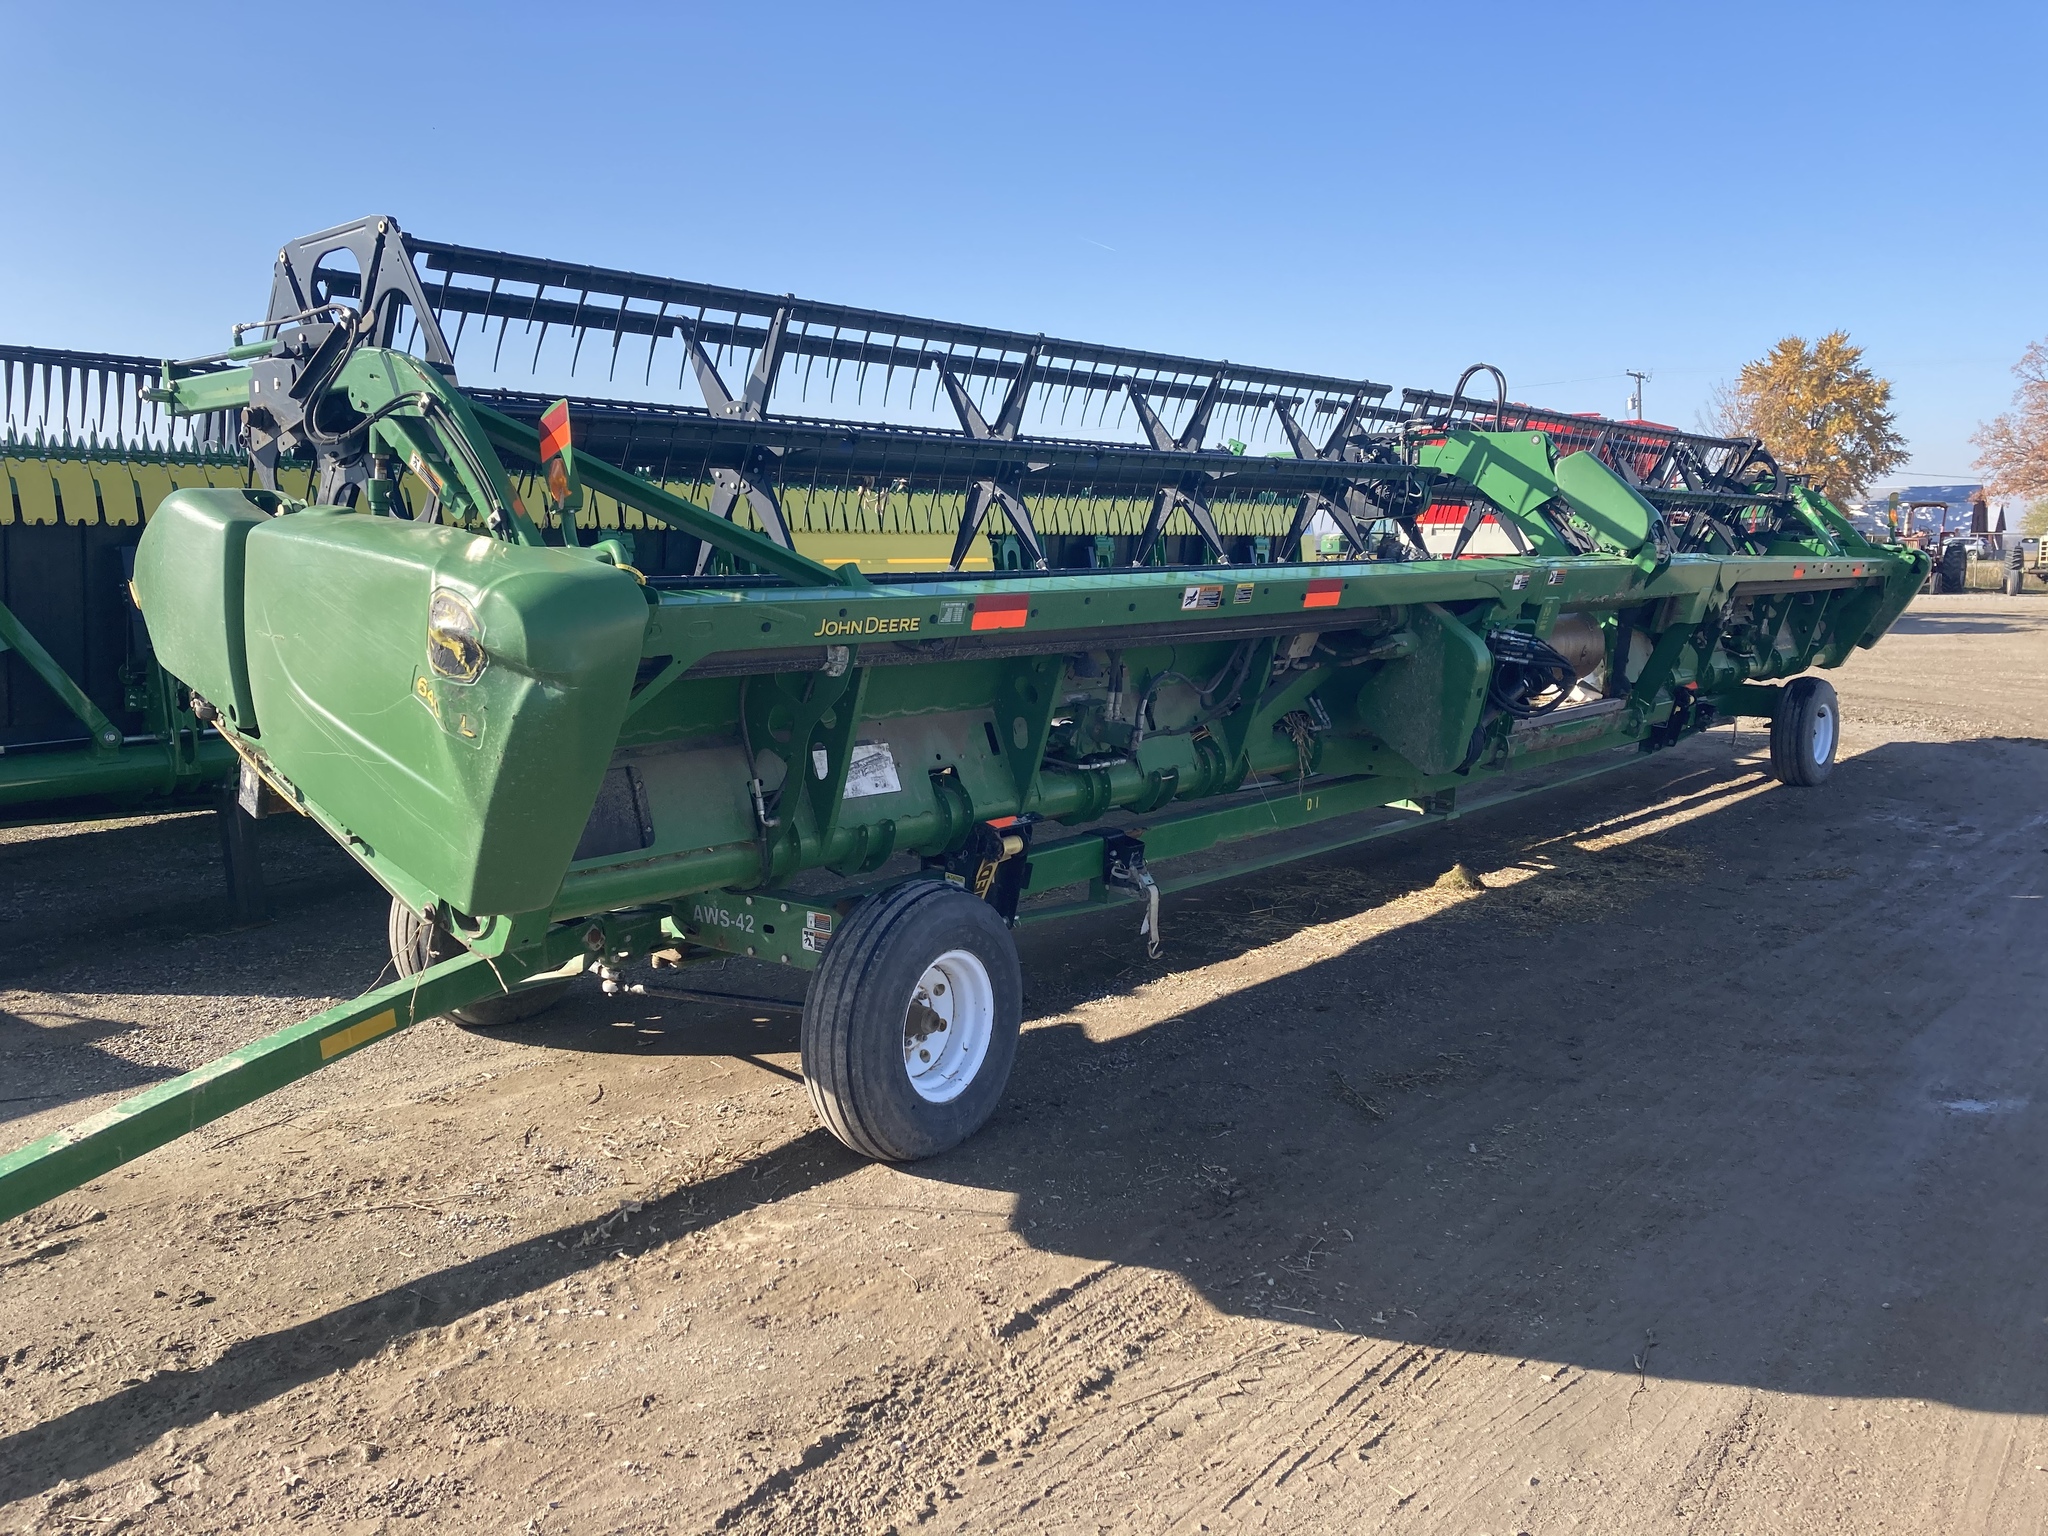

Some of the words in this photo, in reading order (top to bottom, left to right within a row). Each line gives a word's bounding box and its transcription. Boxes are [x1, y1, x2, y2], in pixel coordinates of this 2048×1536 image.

[814, 618, 863, 637] JOHN
[865, 616, 920, 634] DEERE
[693, 904, 755, 934] AWS-42
